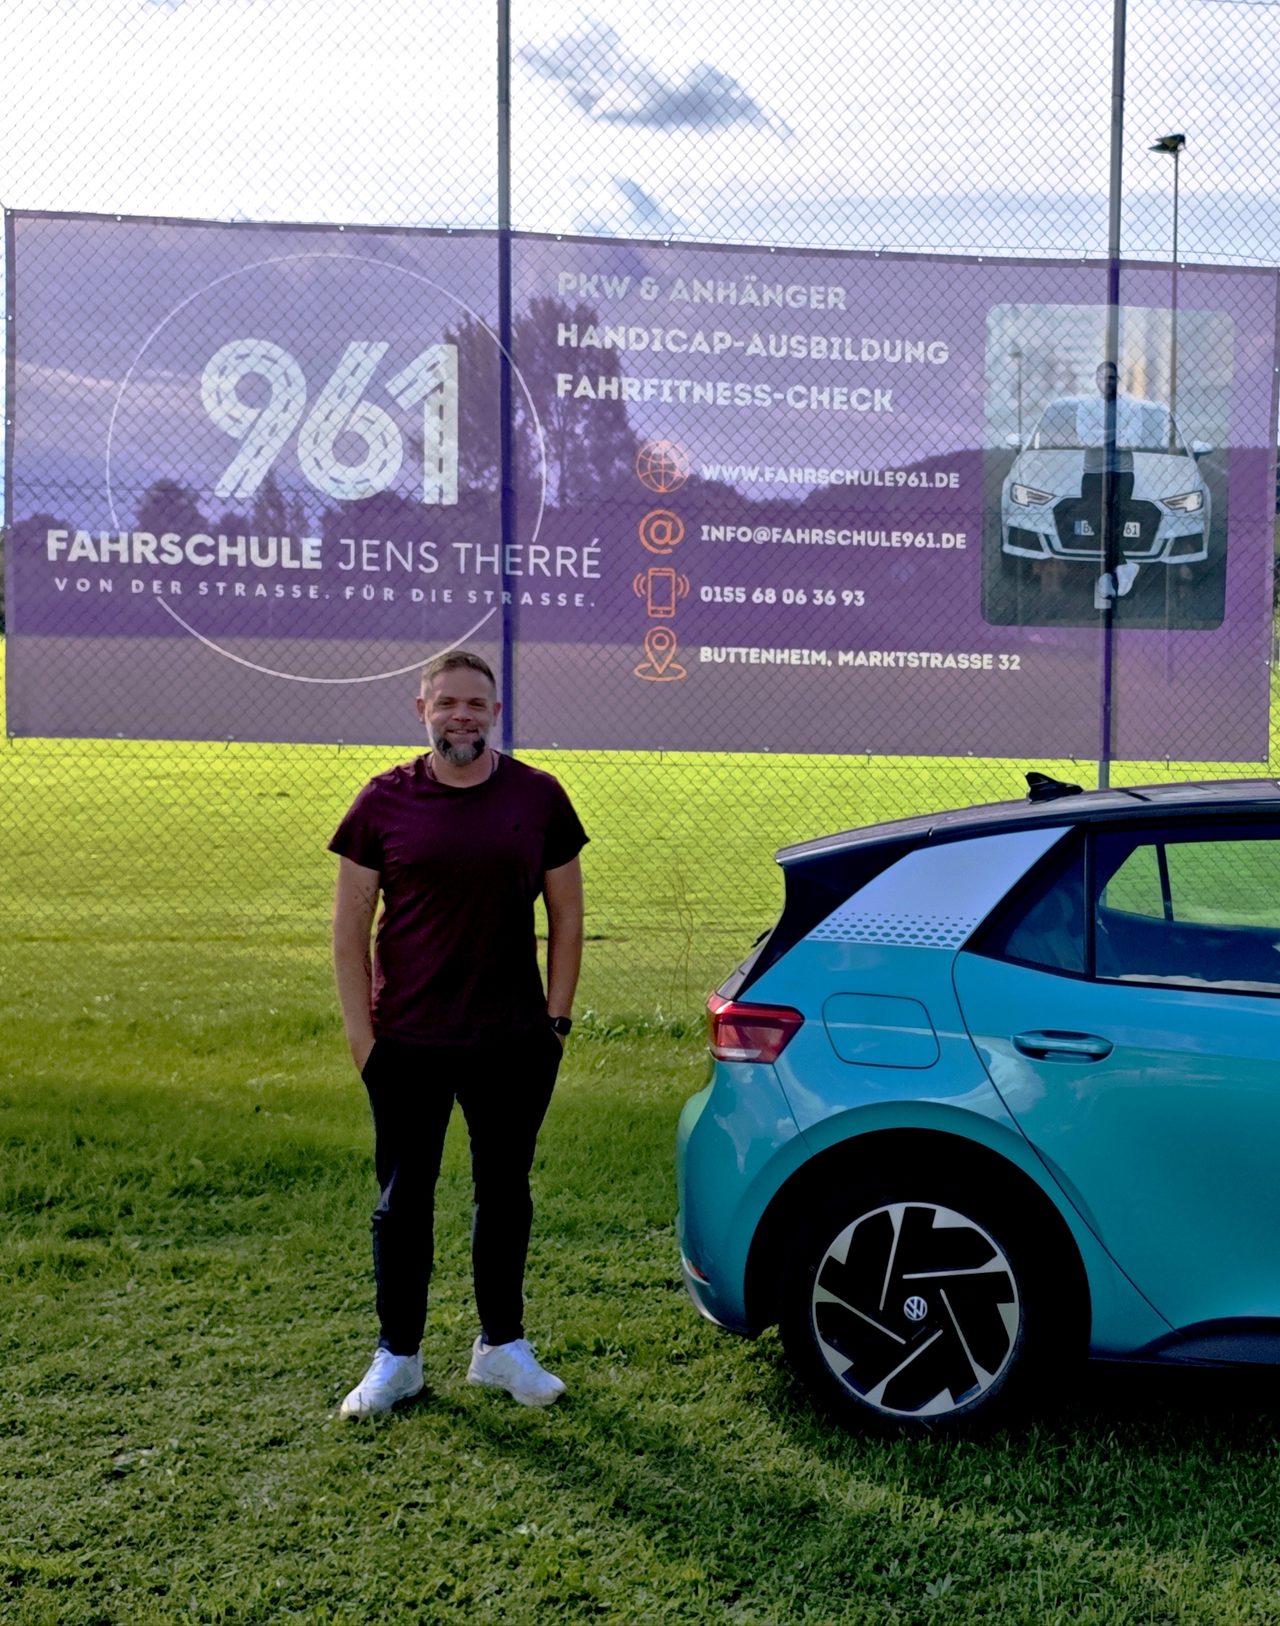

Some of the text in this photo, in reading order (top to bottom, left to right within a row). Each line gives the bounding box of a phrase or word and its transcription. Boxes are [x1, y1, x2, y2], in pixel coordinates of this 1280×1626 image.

[557, 271, 847, 311] PKW & ANHÄNGER
[556, 322, 950, 365] HANDICAP-AUSBILDUNG
[556, 372, 894, 413] FAHRFITNESS-CHECK
[200, 337, 459, 506] 961
[700, 464, 961, 489] WWW.FAHRSCHULE961.DE
[46, 528, 602, 579] FAHRSCHULE JENS THERRÉ
[700, 525, 967, 550] INFO@FAHRSCHULE961.DE
[54, 577, 596, 607] VON DER STRASSE. FÜR DIE STRASSE.
[700, 585, 866, 607] 0155 68 06 36 93
[699, 646, 1022, 671] BUTTENHEIM, MARKTSTRASSE 32
